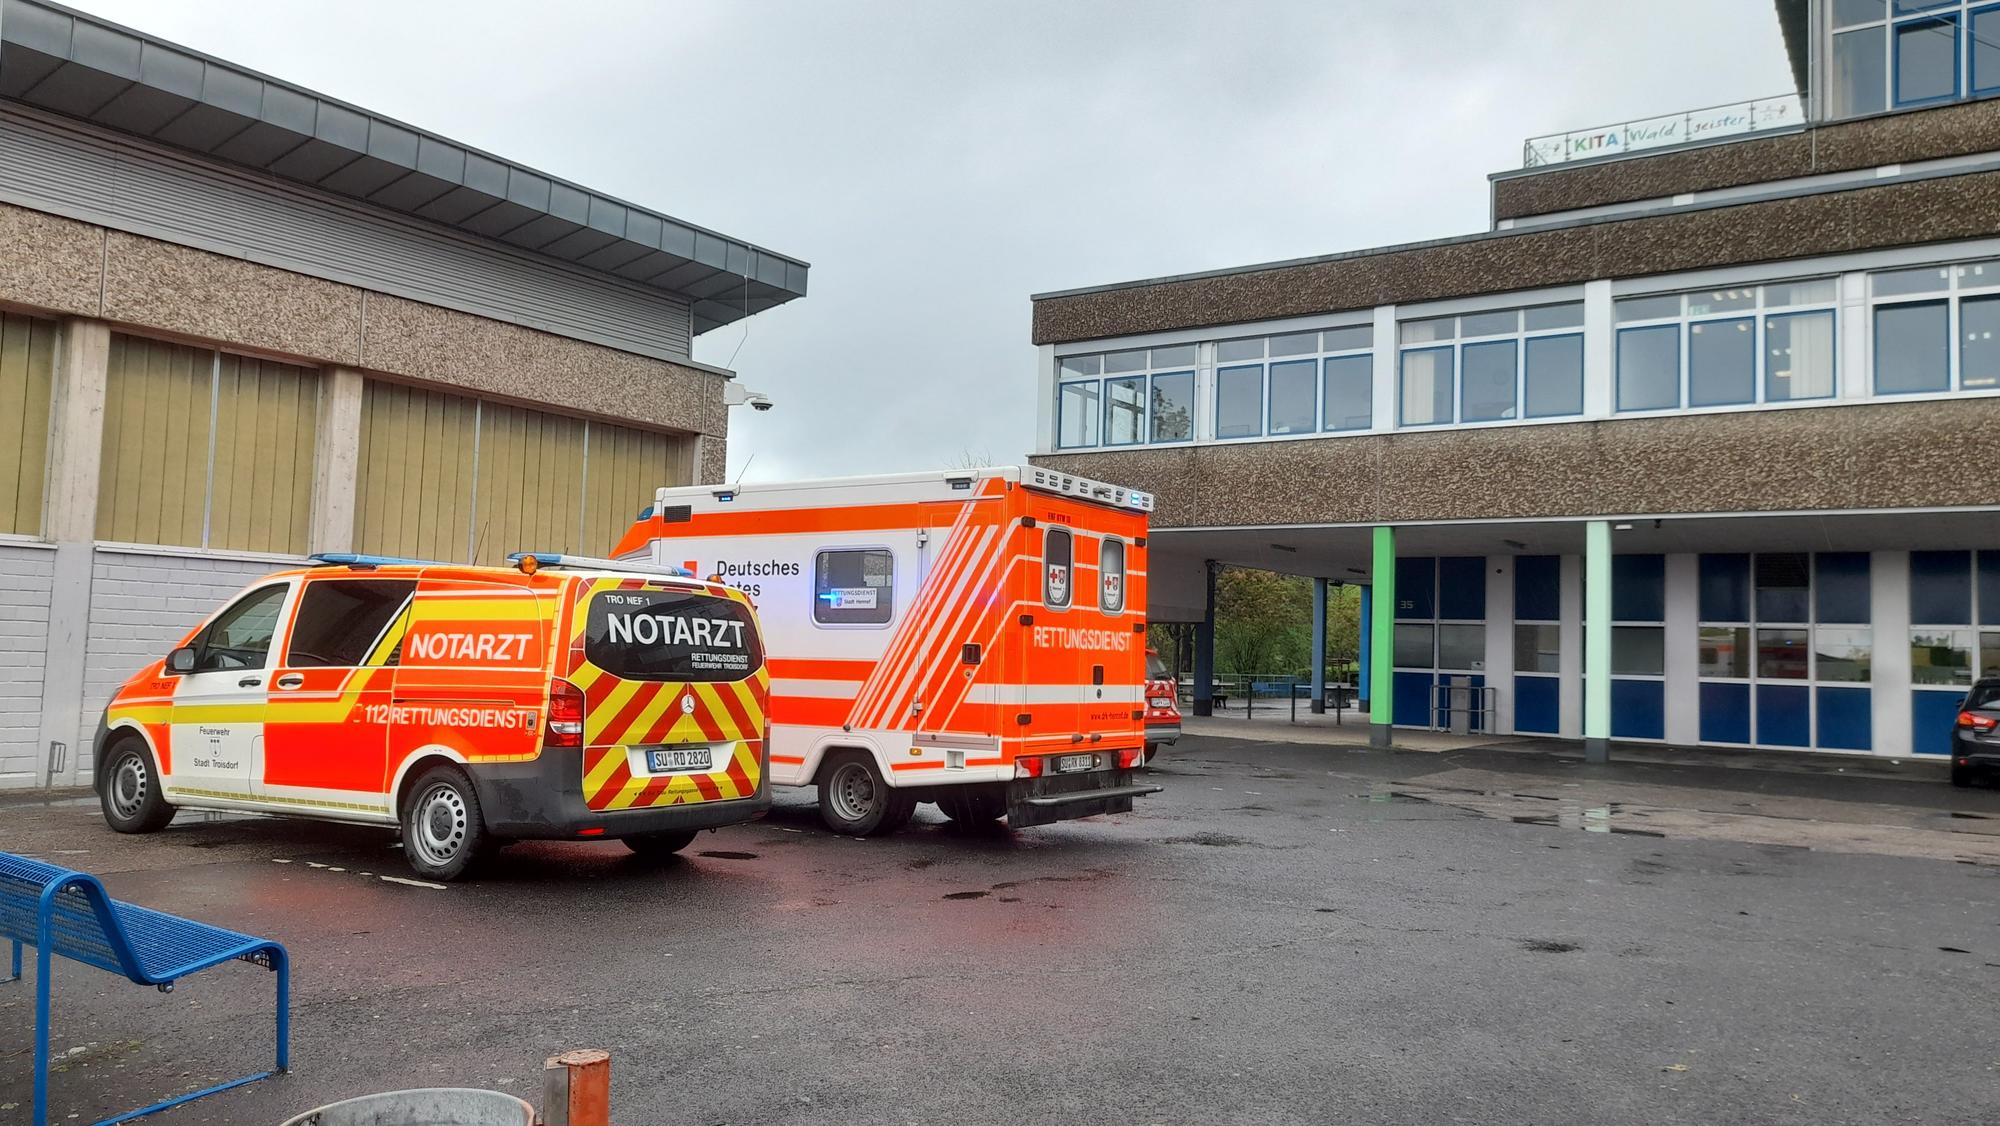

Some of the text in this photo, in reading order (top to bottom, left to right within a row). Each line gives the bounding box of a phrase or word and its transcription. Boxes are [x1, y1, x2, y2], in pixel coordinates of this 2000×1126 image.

[1574, 132, 1619, 152] KITA
[1628, 122, 1677, 142] Wald
[717, 560, 800, 576] Deutsches
[605, 595, 650, 606] TRO NEF 1
[1400, 600, 1415, 609] 35
[607, 613, 745, 648] NOTARZT
[409, 633, 533, 660] NOTARZT
[1033, 626, 1132, 652] RETTUNGSDIENST
[691, 653, 748, 663] RETTUNGSDIENST
[365, 704, 527, 729] 112 RETTUNGSDIENST
[199, 726, 231, 736] Feuerwehr
[193, 758, 239, 770] Stadt Troisdorf
[655, 750, 710, 767] SU RD 2820
